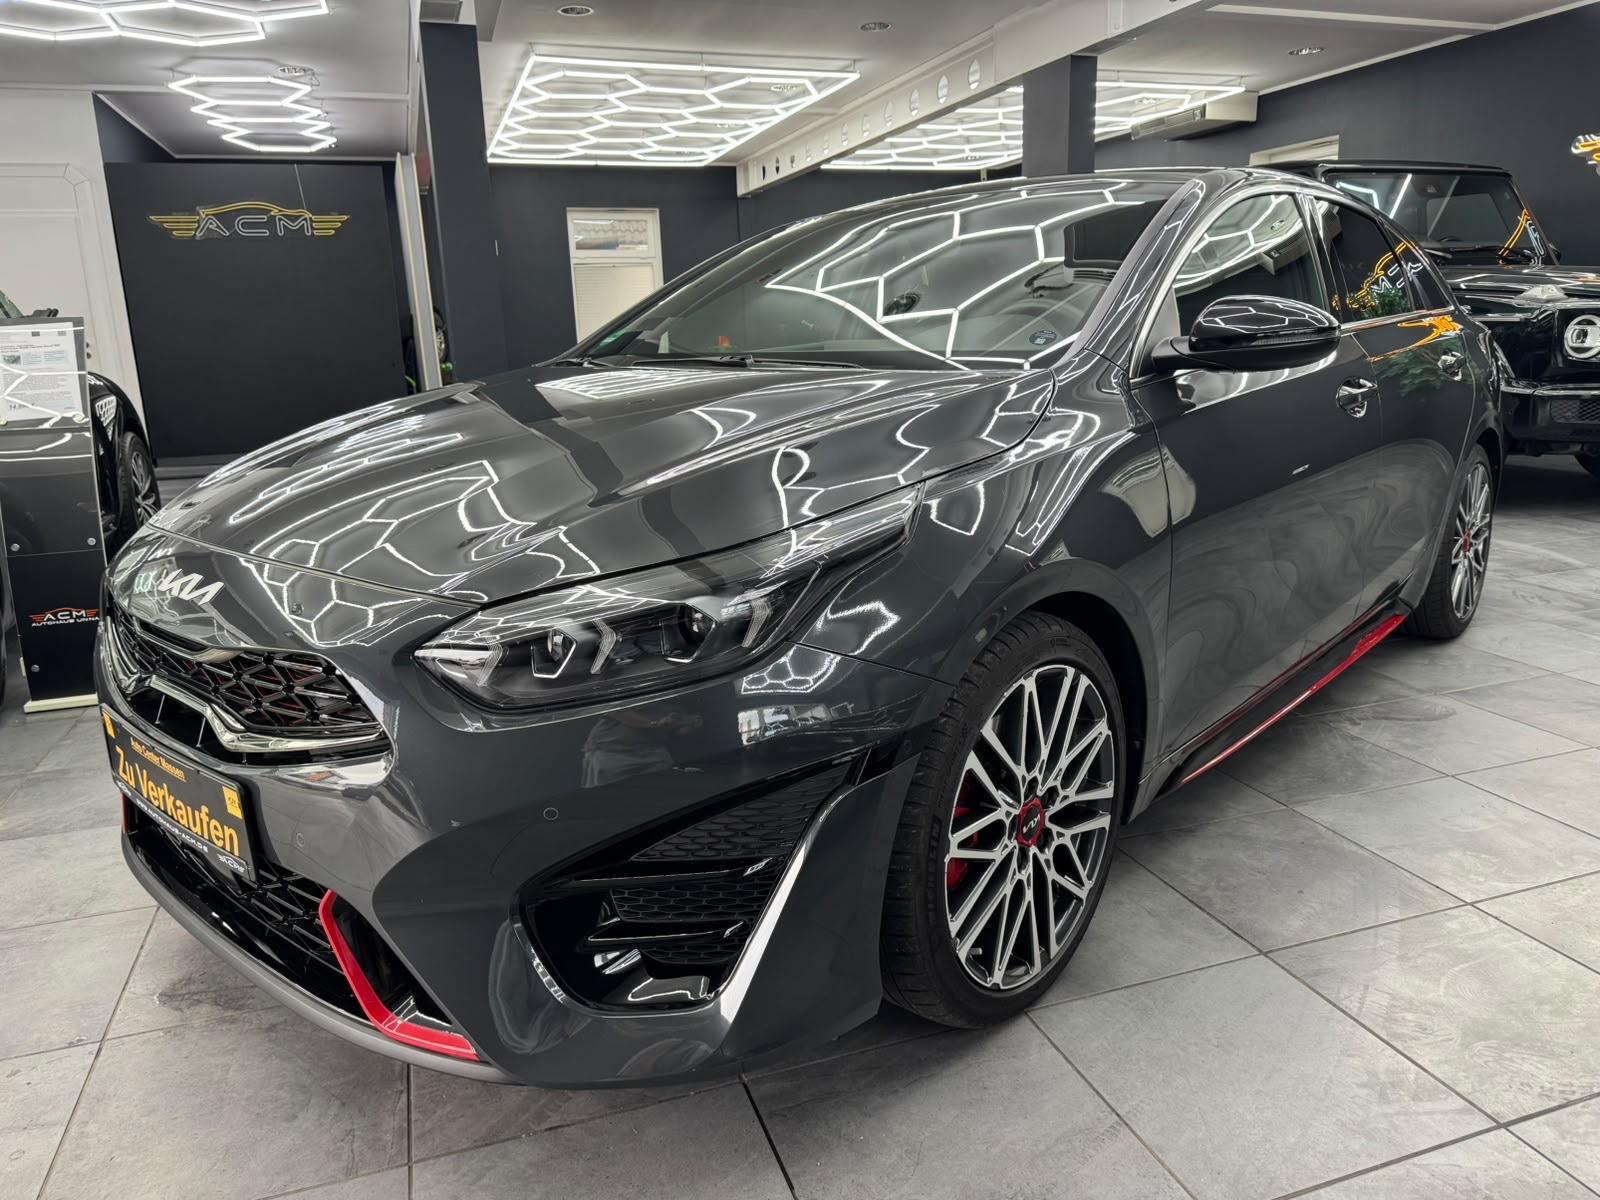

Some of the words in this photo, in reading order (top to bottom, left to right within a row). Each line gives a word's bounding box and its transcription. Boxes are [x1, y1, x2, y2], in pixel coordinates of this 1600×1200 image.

[196, 215, 312, 236] ACM
[158, 569, 224, 605] KIA
[32, 619, 75, 627] AUTOHAUS
[44, 610, 86, 621] ACM
[115, 745, 136, 789] Zu
[135, 762, 239, 857] Verkaufen
